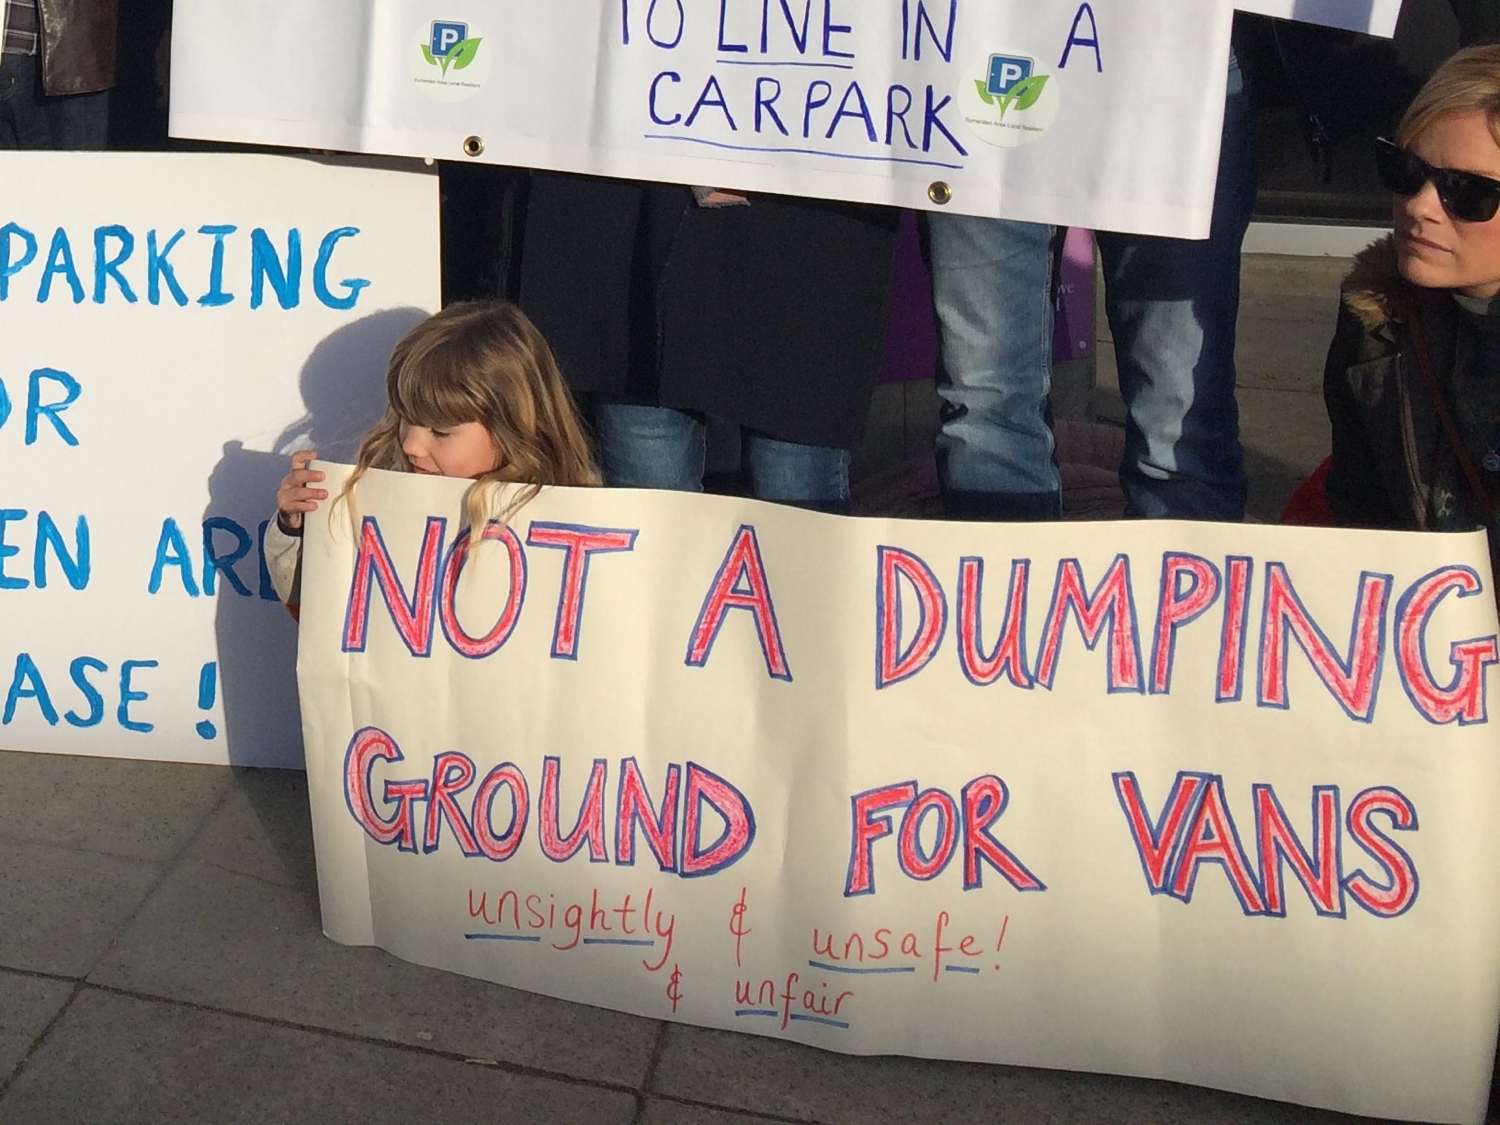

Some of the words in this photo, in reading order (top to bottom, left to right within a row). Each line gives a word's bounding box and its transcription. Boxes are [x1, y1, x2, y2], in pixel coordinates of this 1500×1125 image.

[1059, 3, 1101, 71] A
[650, 72, 967, 155] CARPARK
[341, 515, 638, 660] NOT
[686, 526, 791, 681] A
[876, 545, 1498, 726] DUMPING
[345, 731, 755, 878] GROUND
[845, 774, 1046, 897] FOR
[1111, 771, 1418, 919] VANS
[468, 888, 675, 970] unsightly
[812, 912, 1009, 981] unsafe!
[735, 974, 855, 1030] unfair
